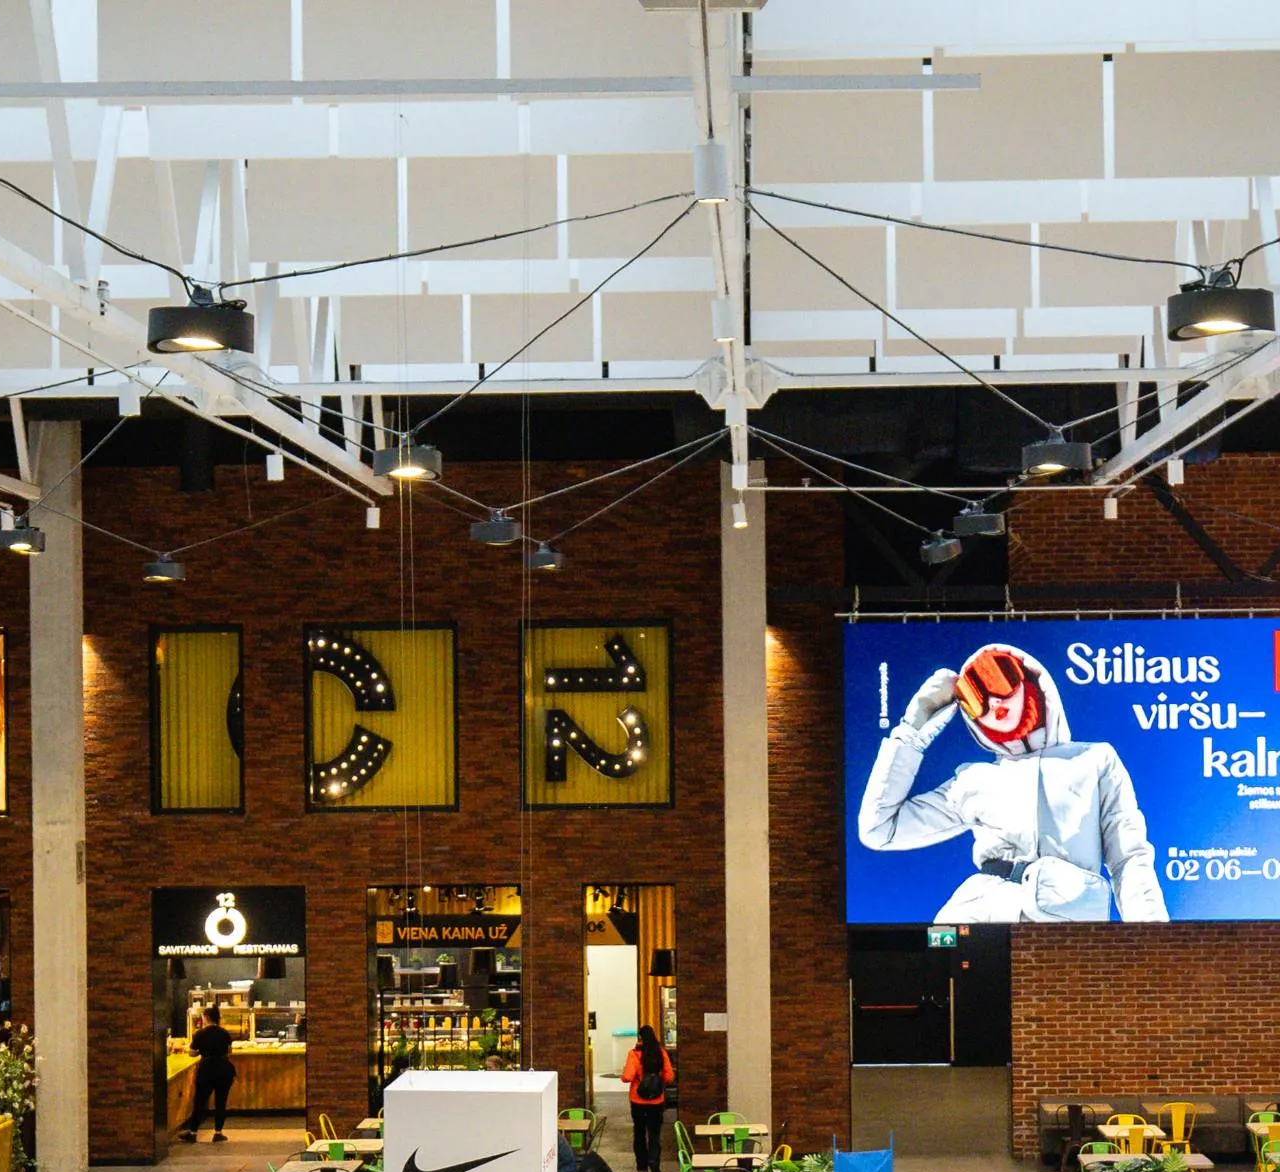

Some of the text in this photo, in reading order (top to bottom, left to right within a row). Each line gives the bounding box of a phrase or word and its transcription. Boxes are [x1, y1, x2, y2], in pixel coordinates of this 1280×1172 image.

[1066, 642, 1220, 685] Stiliaus
[1237, 783, 1274, 796] Žiemos
[1166, 859, 1200, 880] 02
[216, 892, 236, 908] 12
[397, 922, 508, 941] VIENA KAINA UŽ
[158, 943, 299, 956] SAVITARNOS RESTORANAS
